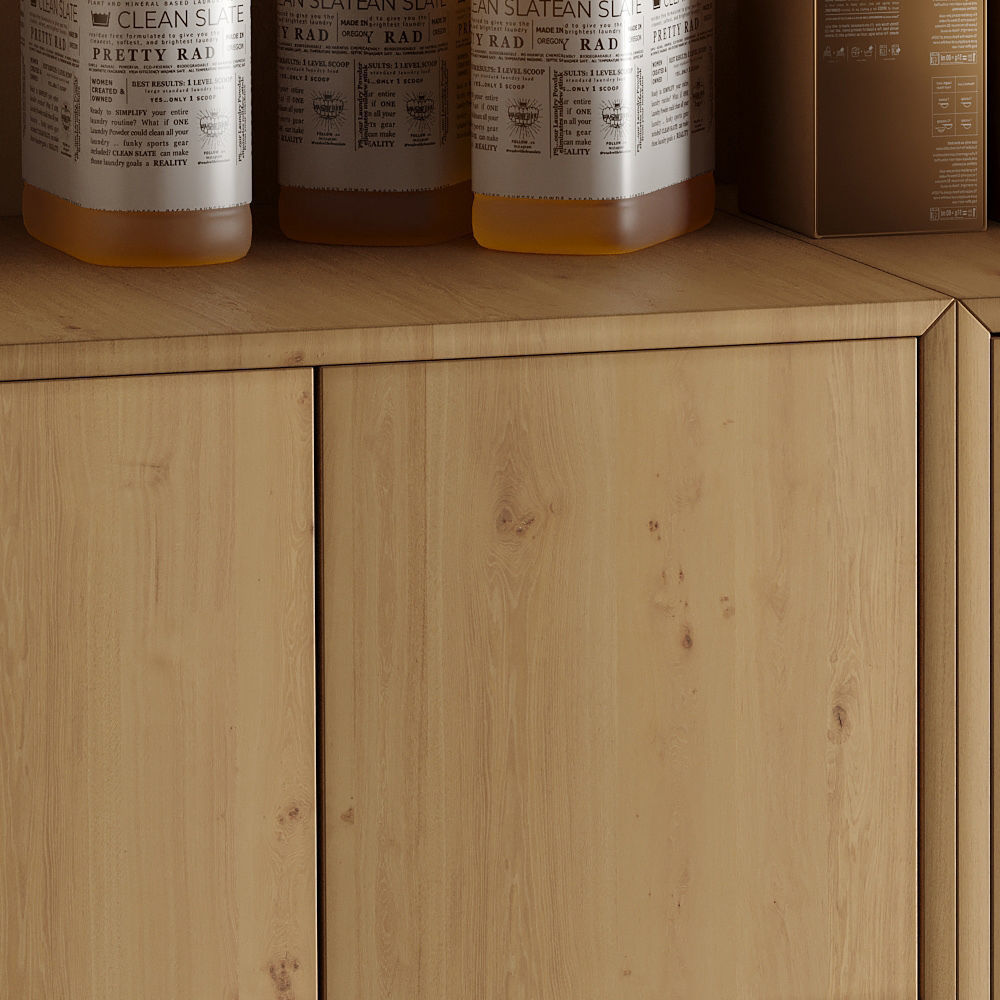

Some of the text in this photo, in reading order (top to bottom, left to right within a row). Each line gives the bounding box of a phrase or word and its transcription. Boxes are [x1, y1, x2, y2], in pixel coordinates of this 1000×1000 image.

[58, 0, 78, 23] SLATE
[118, 4, 244, 29] CLEAN SLATE
[295, 27, 329, 41] RAD
[653, 17, 699, 43] PRETTY RAD
[162, 38, 193, 46] brightest
[384, 30, 423, 43] RAD
[489, 35, 524, 49] RAD
[580, 37, 618, 51] RAD
[93, 47, 166, 61] PRETTY
[177, 46, 215, 61] RAD
[308, 59, 327, 67] LEVEL
[92, 78, 113, 86] WOMEN
[92, 87, 117, 95] CREATED
[90, 107, 104, 115] Ready
[109, 128, 129, 136] Powder
[174, 129, 189, 137] your
[146, 140, 169, 148] sports
[173, 140, 189, 148] gear
[103, 159, 124, 167] laundry
[126, 159, 142, 167] goals
